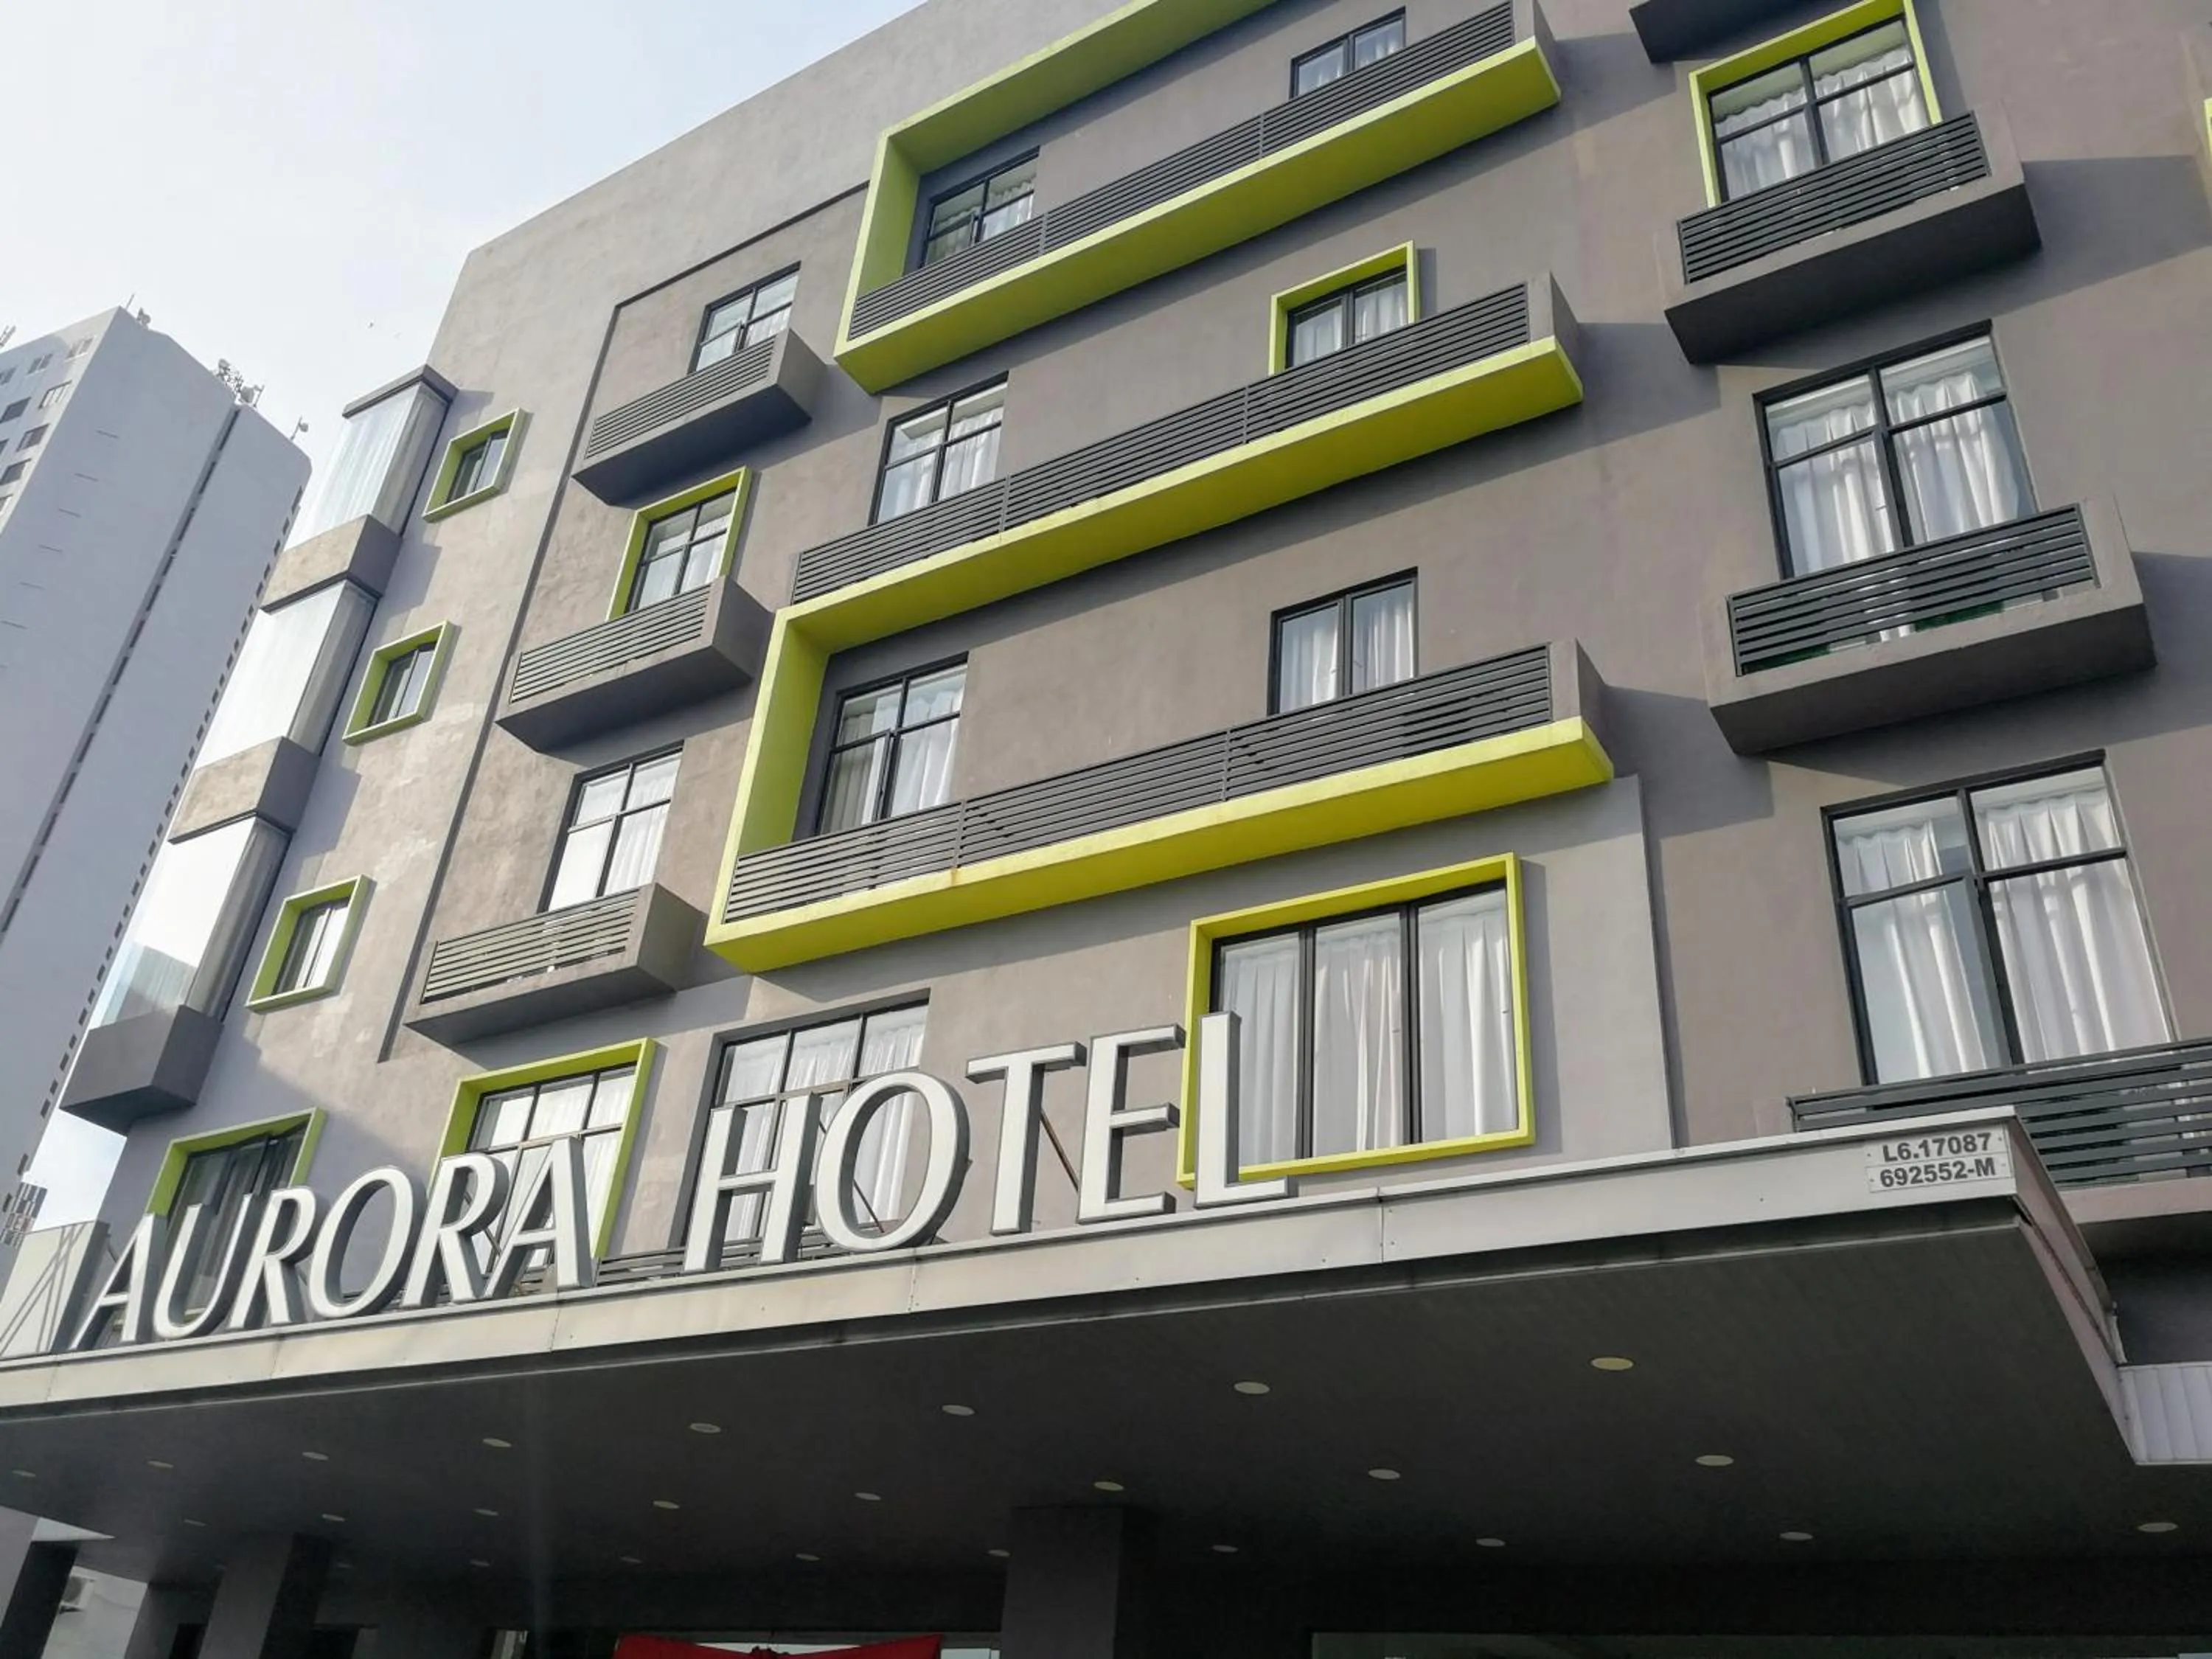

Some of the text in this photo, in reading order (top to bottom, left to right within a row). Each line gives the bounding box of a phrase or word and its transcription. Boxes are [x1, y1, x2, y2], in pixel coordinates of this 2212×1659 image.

[1882, 1133, 1992, 1163] L6.17087
[66, 1010, 1296, 1351] AURORA HOTEL
[1879, 1157, 1996, 1188] 692552-M
